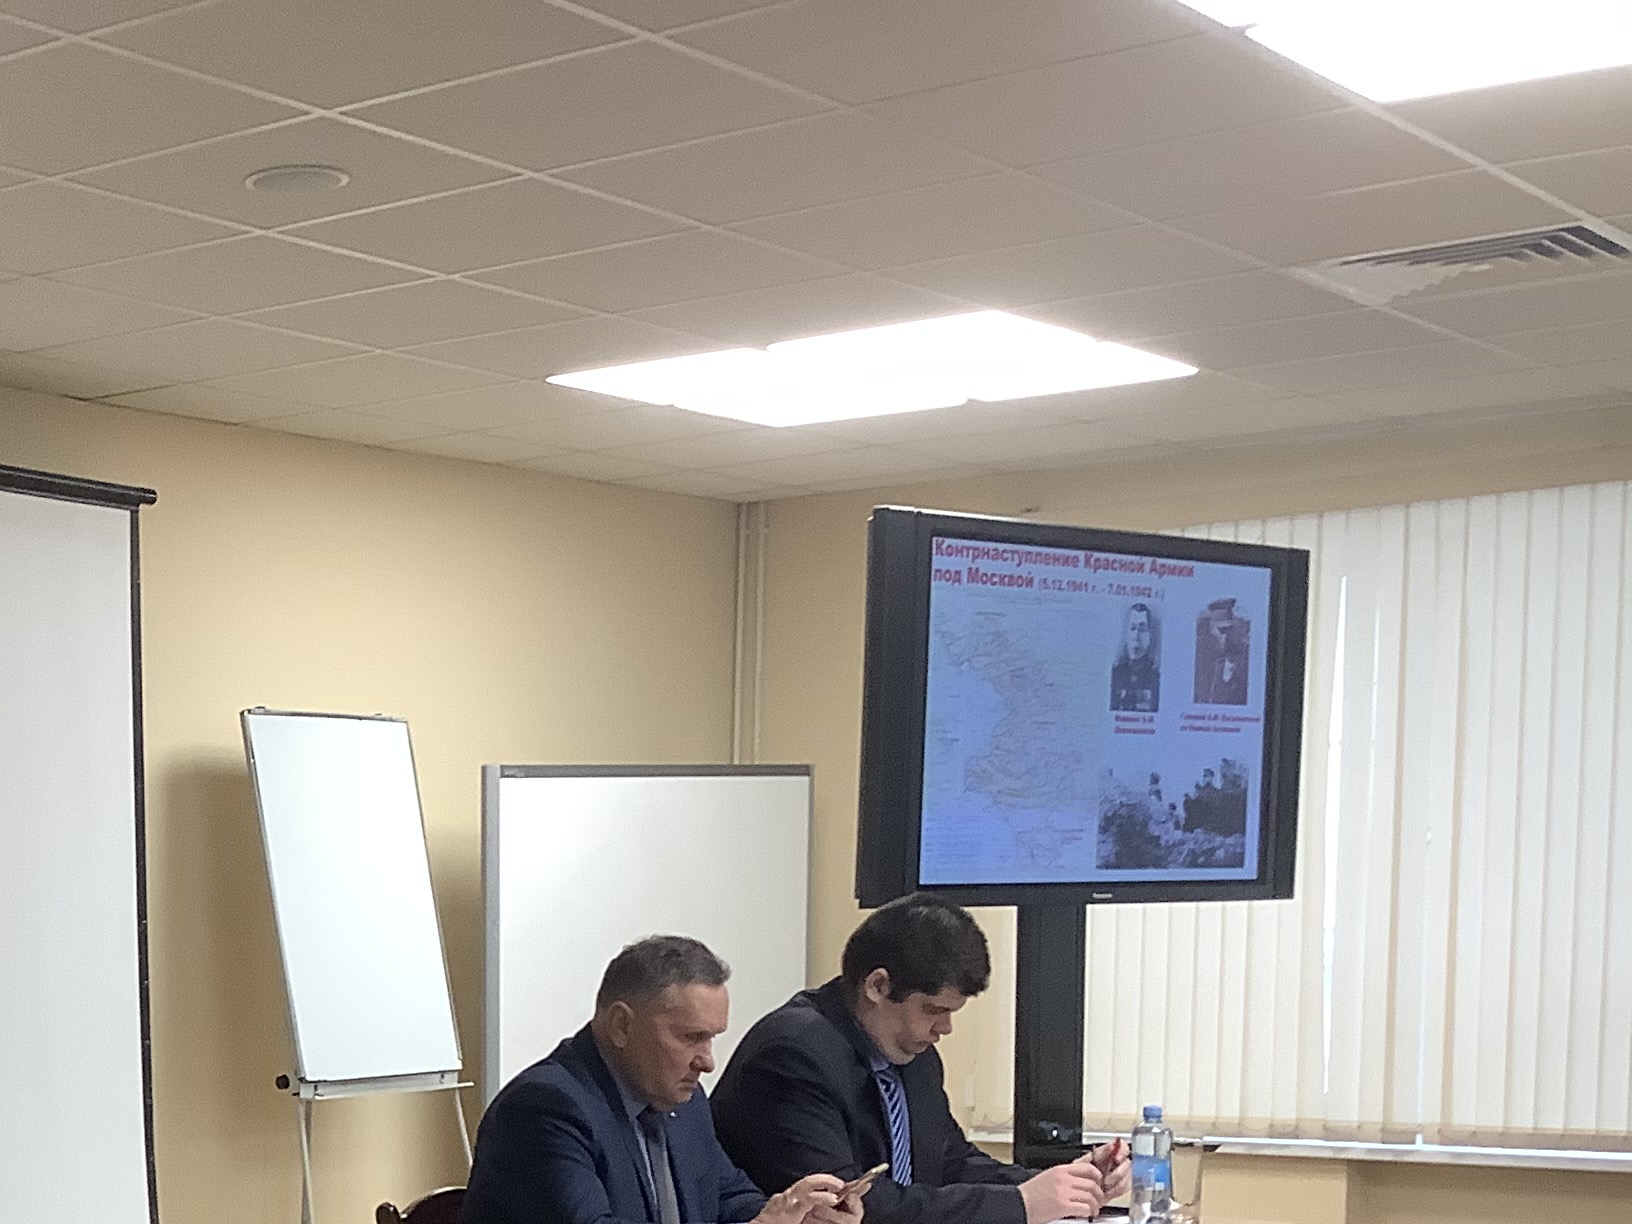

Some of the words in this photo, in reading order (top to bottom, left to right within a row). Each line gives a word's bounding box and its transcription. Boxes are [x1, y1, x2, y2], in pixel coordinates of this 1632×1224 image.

[933, 538, 1079, 568] Контрнаступление
[1084, 552, 1145, 574] Красной
[1149, 559, 1194, 579] Армии
[933, 568, 962, 586] под
[967, 567, 1034, 589] Москвой
